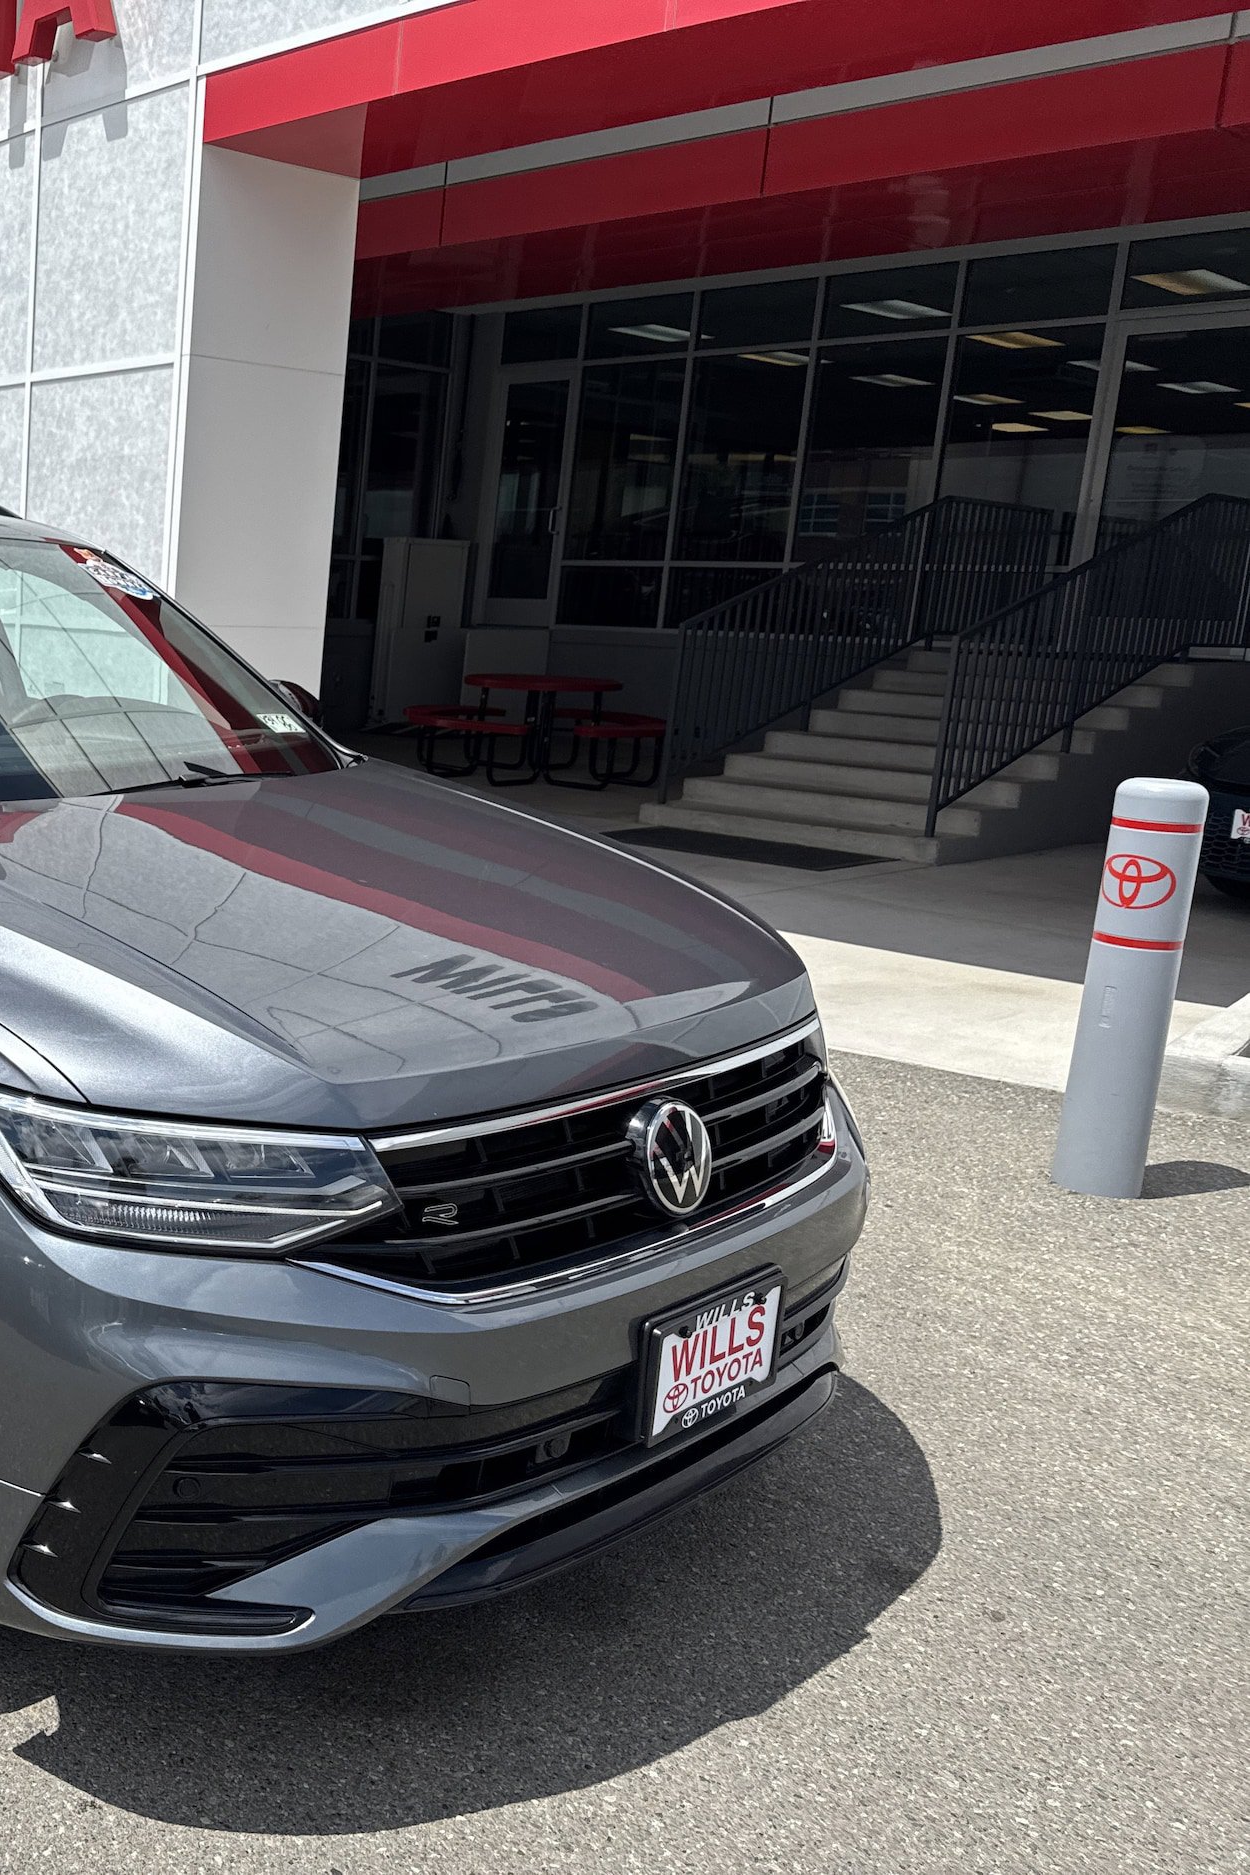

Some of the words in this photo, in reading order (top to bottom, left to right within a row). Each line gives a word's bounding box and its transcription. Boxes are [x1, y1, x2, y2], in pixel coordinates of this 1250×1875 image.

[695, 1292, 756, 1331] WILLS
[671, 1305, 766, 1383] WILLS
[690, 1347, 764, 1399] TOYOTA
[700, 1385, 746, 1418] TOYOTA
